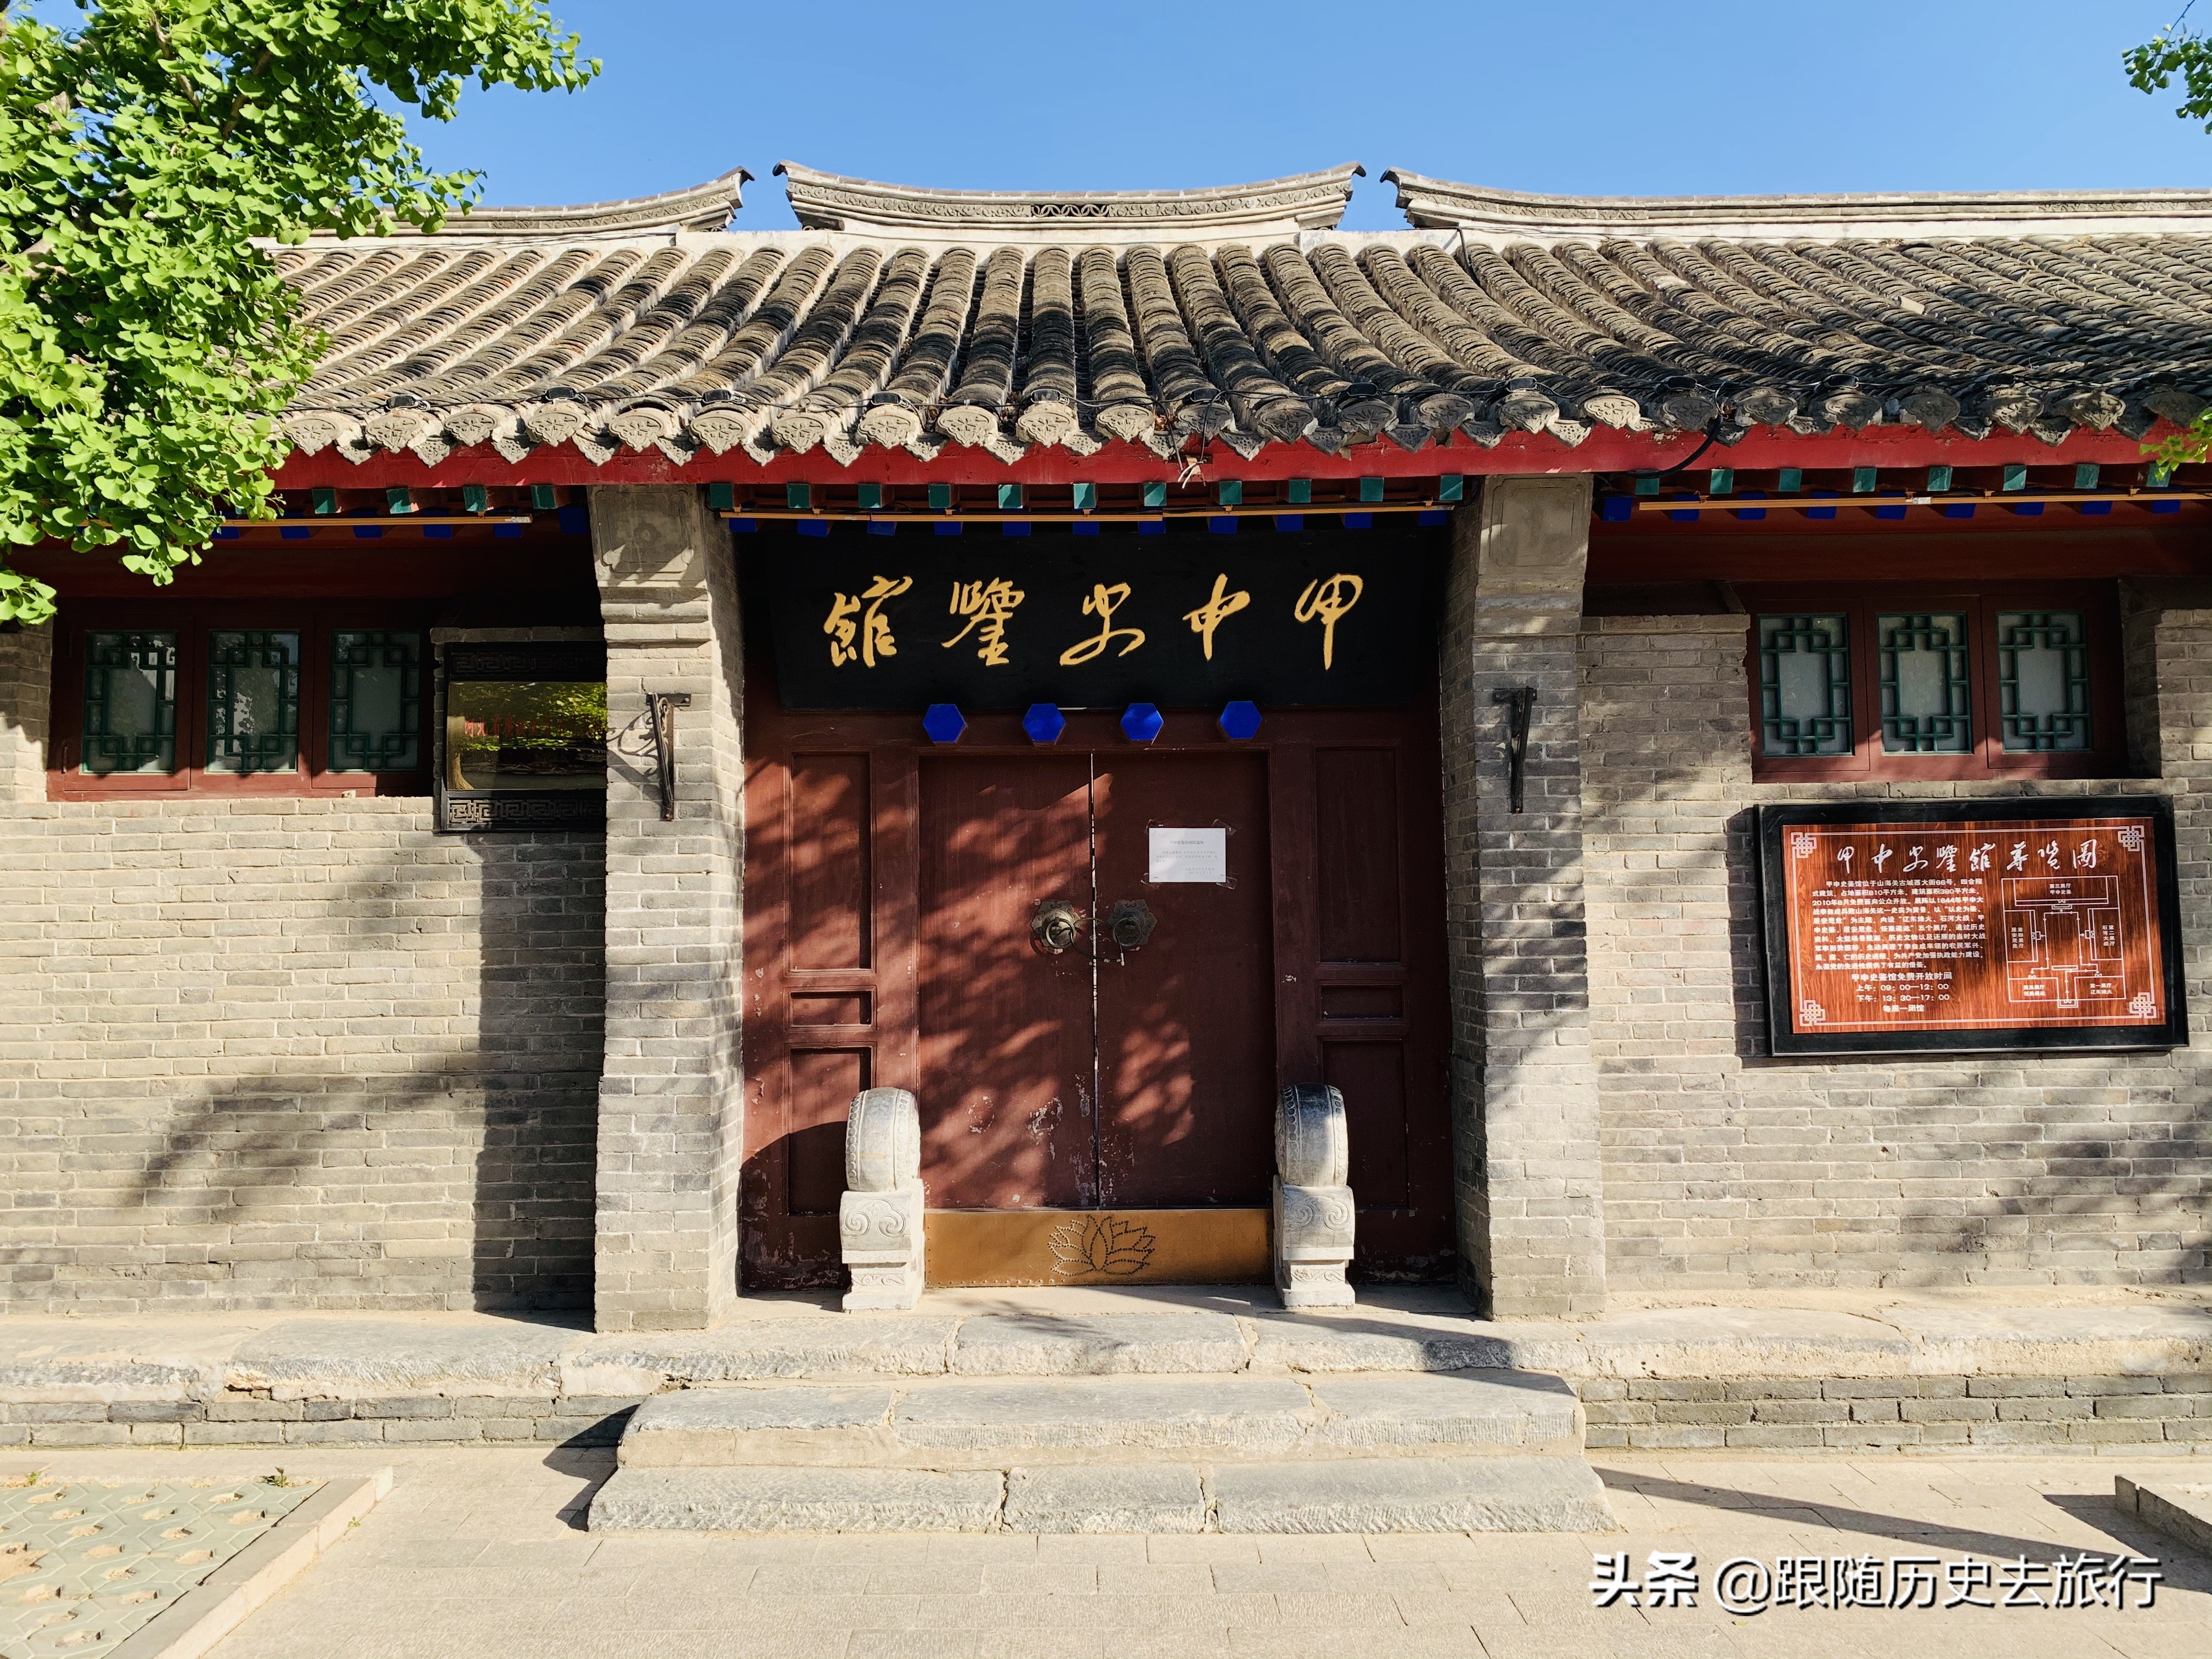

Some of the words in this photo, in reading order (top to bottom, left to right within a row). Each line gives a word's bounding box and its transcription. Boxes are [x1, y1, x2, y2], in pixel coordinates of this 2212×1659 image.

[1852, 972, 1952, 981] 甲申史鉴馆免费开放时间
[1882, 1004, 1925, 1013] 每周一闭馆
